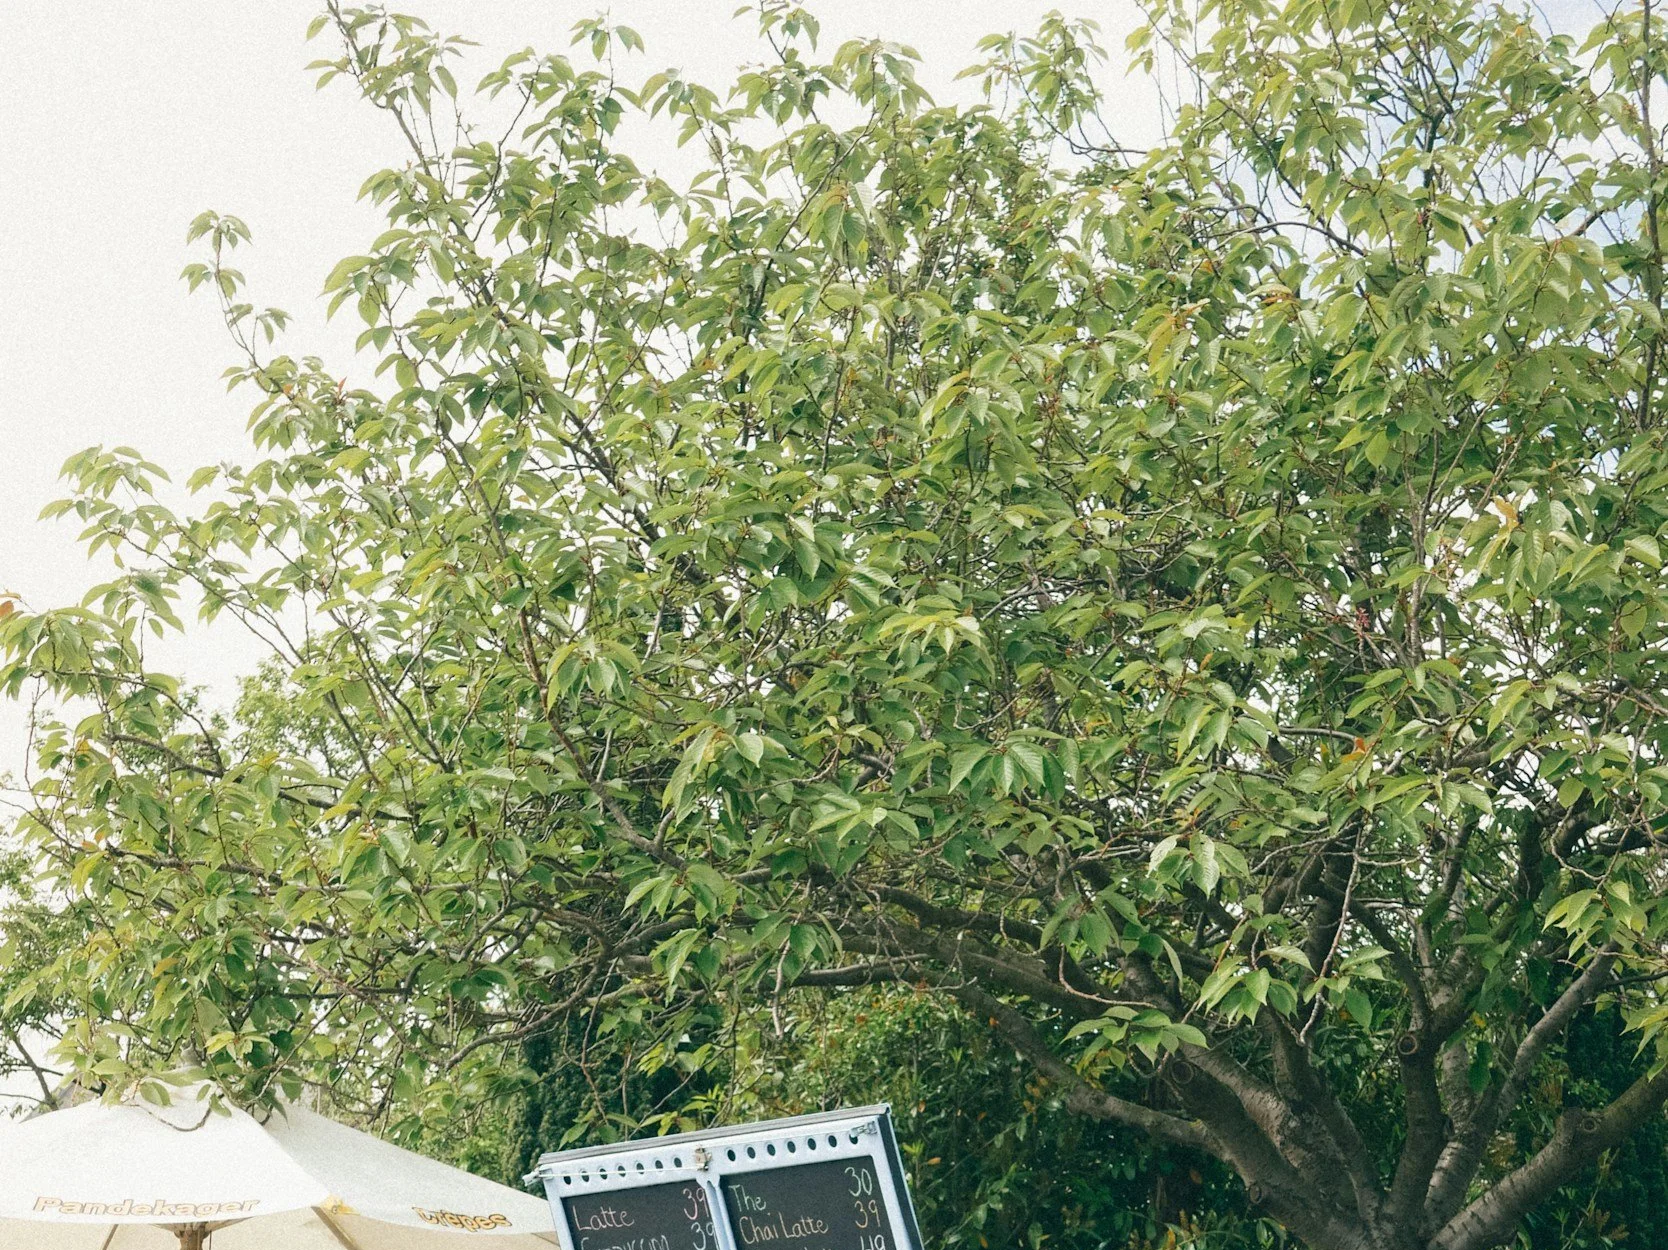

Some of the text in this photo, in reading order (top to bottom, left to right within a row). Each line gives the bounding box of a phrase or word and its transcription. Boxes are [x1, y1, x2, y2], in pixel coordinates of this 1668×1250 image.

[32, 1196, 261, 1218] Pandekager
[572, 1187, 710, 1231] Latte 39
[728, 1166, 873, 1212] The 30
[739, 1199, 881, 1244] Chai Latte 39
